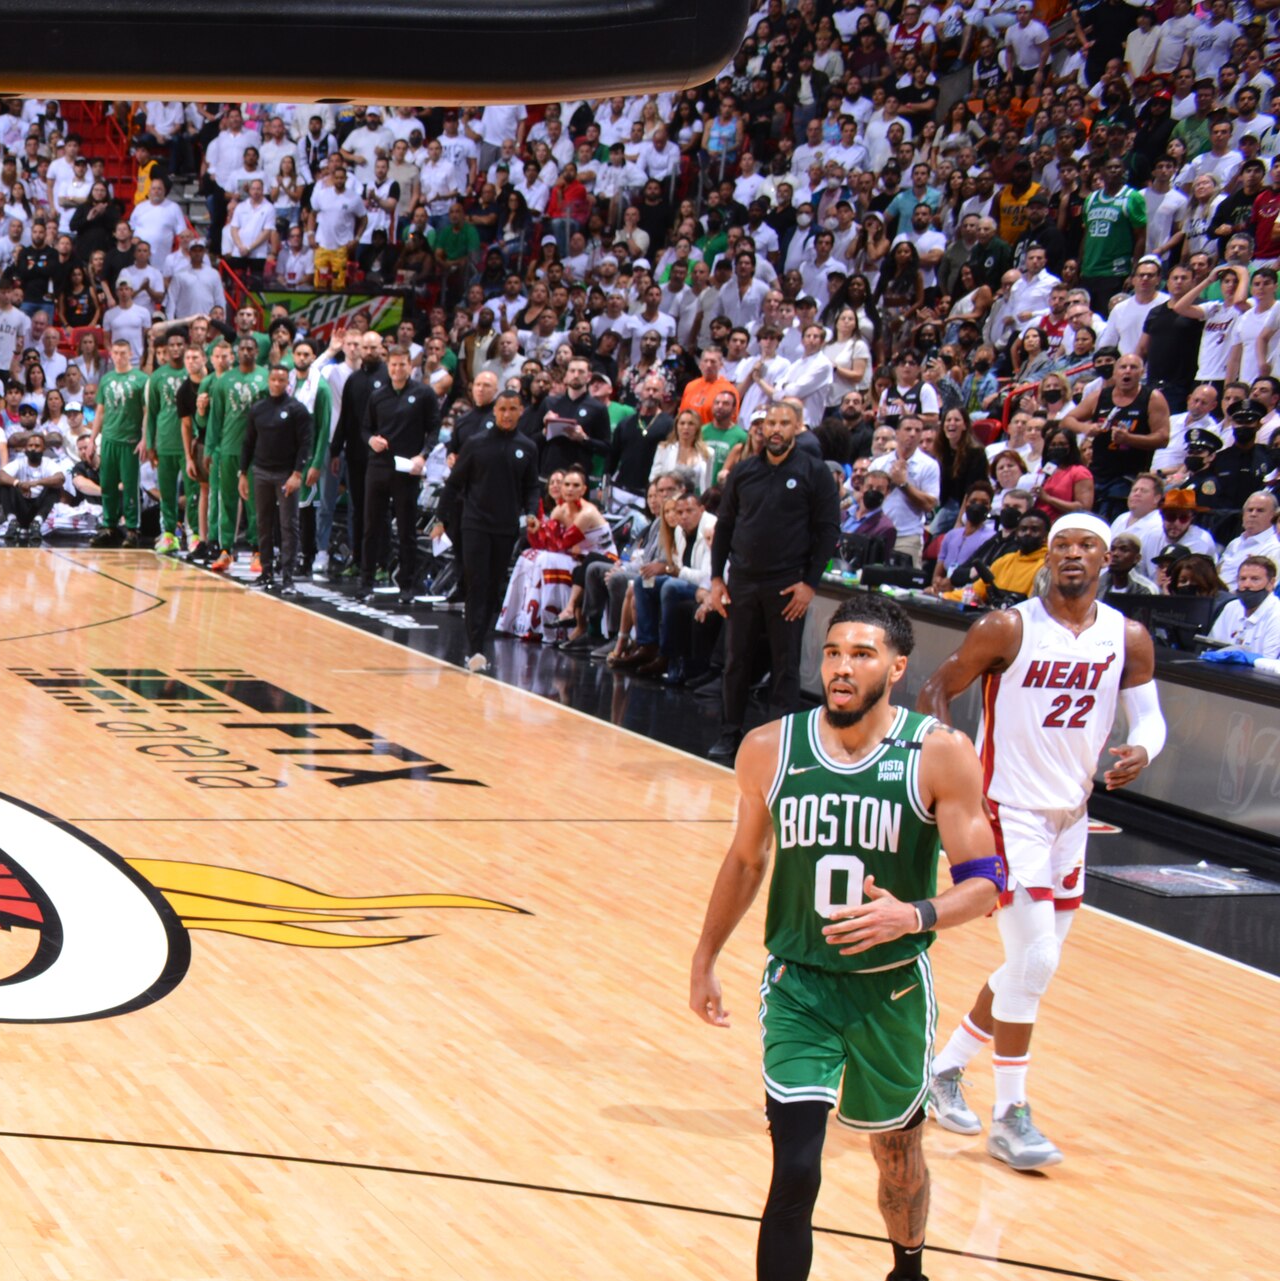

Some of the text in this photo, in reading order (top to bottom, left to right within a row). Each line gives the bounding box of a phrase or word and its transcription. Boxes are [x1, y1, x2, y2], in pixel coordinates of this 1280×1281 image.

[1022, 652, 1116, 690] HEAT
[1042, 694, 1096, 728] 22
[95, 720, 290, 790] arena
[895, 739, 906, 748] 24
[878, 771, 904, 781] PRINT
[879, 759, 904, 772] VISTA
[780, 793, 902, 853] BOSTON
[814, 854, 865, 919] 0
